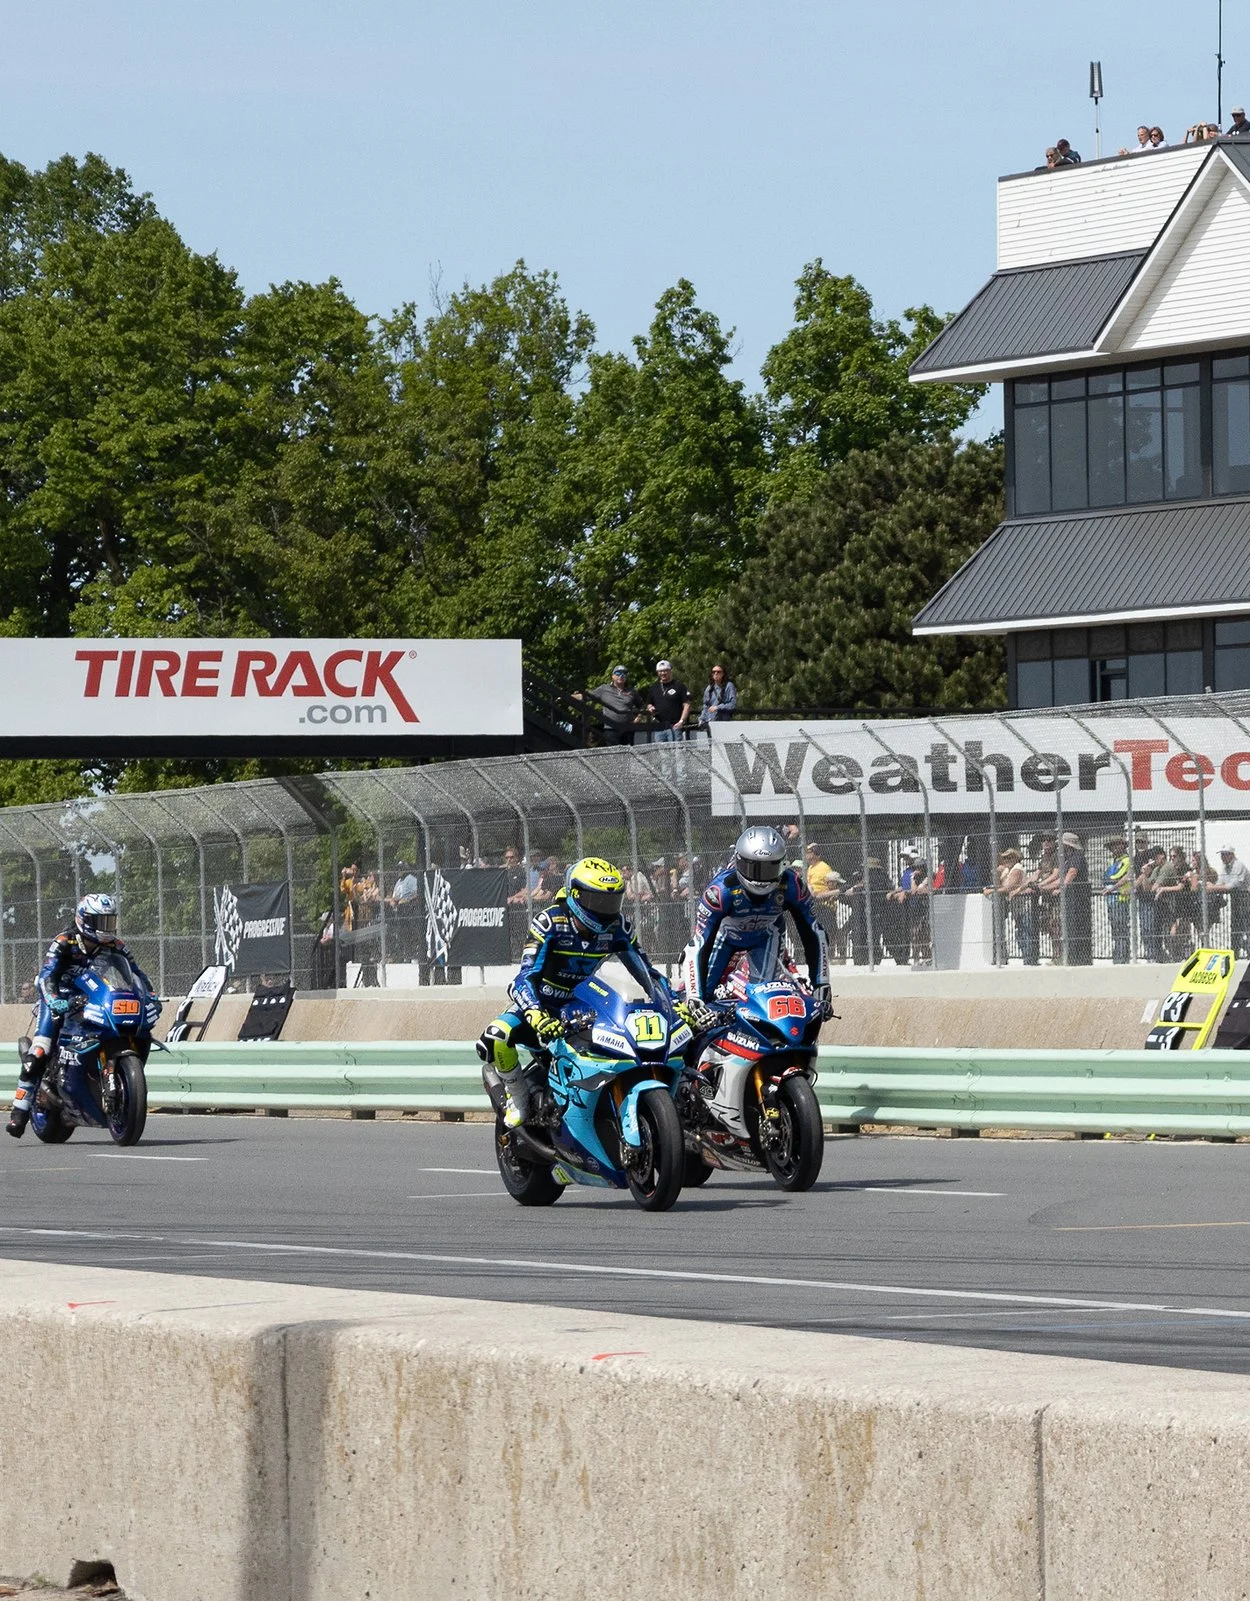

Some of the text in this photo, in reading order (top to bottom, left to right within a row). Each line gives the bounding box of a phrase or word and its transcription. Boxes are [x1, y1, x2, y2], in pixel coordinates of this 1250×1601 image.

[75, 649, 421, 723] TIRE RACK
[298, 703, 387, 724] .com
[458, 907, 505, 927] PROGRESSIVE
[243, 917, 286, 939] PROGRESSIVE
[688, 960, 698, 995] SUZUKI
[751, 981, 796, 994] SUZUKI
[113, 1001, 139, 1014] 50
[768, 995, 807, 1021] 66
[635, 1015, 664, 1042] 11
[673, 1030, 691, 1046] YAMAHA
[597, 1035, 625, 1049] YAMAHA
[727, 1032, 760, 1051] SUZUKI
